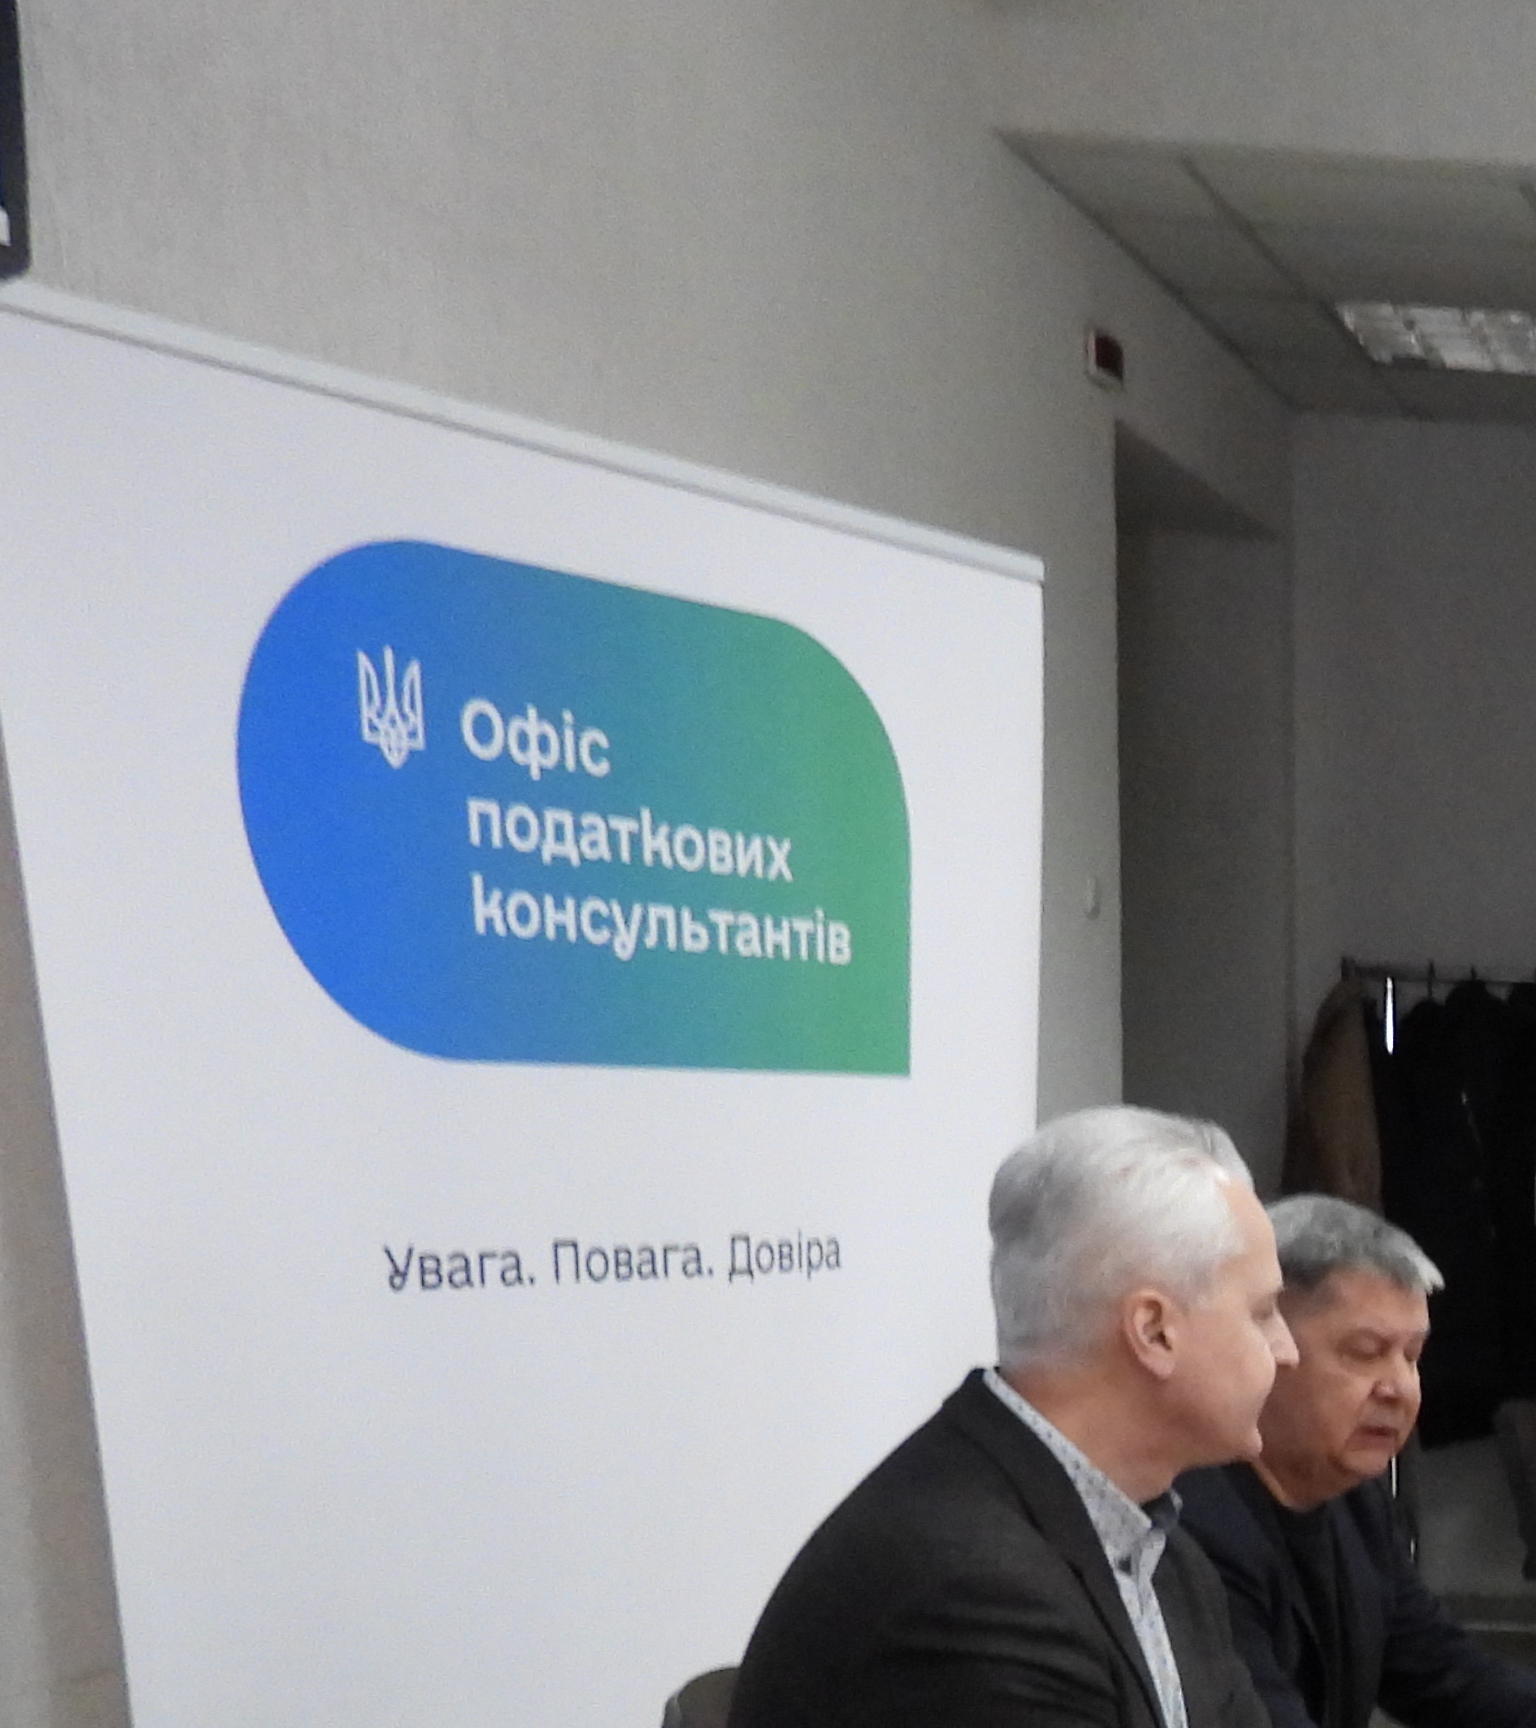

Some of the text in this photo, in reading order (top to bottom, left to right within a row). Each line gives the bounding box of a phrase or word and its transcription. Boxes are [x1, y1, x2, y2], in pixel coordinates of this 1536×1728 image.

[459, 697, 611, 780] Офіс
[466, 797, 794, 882] податкових
[471, 872, 853, 964] консультантів
[384, 1229, 841, 1291] Увага. Повага. Довіра
